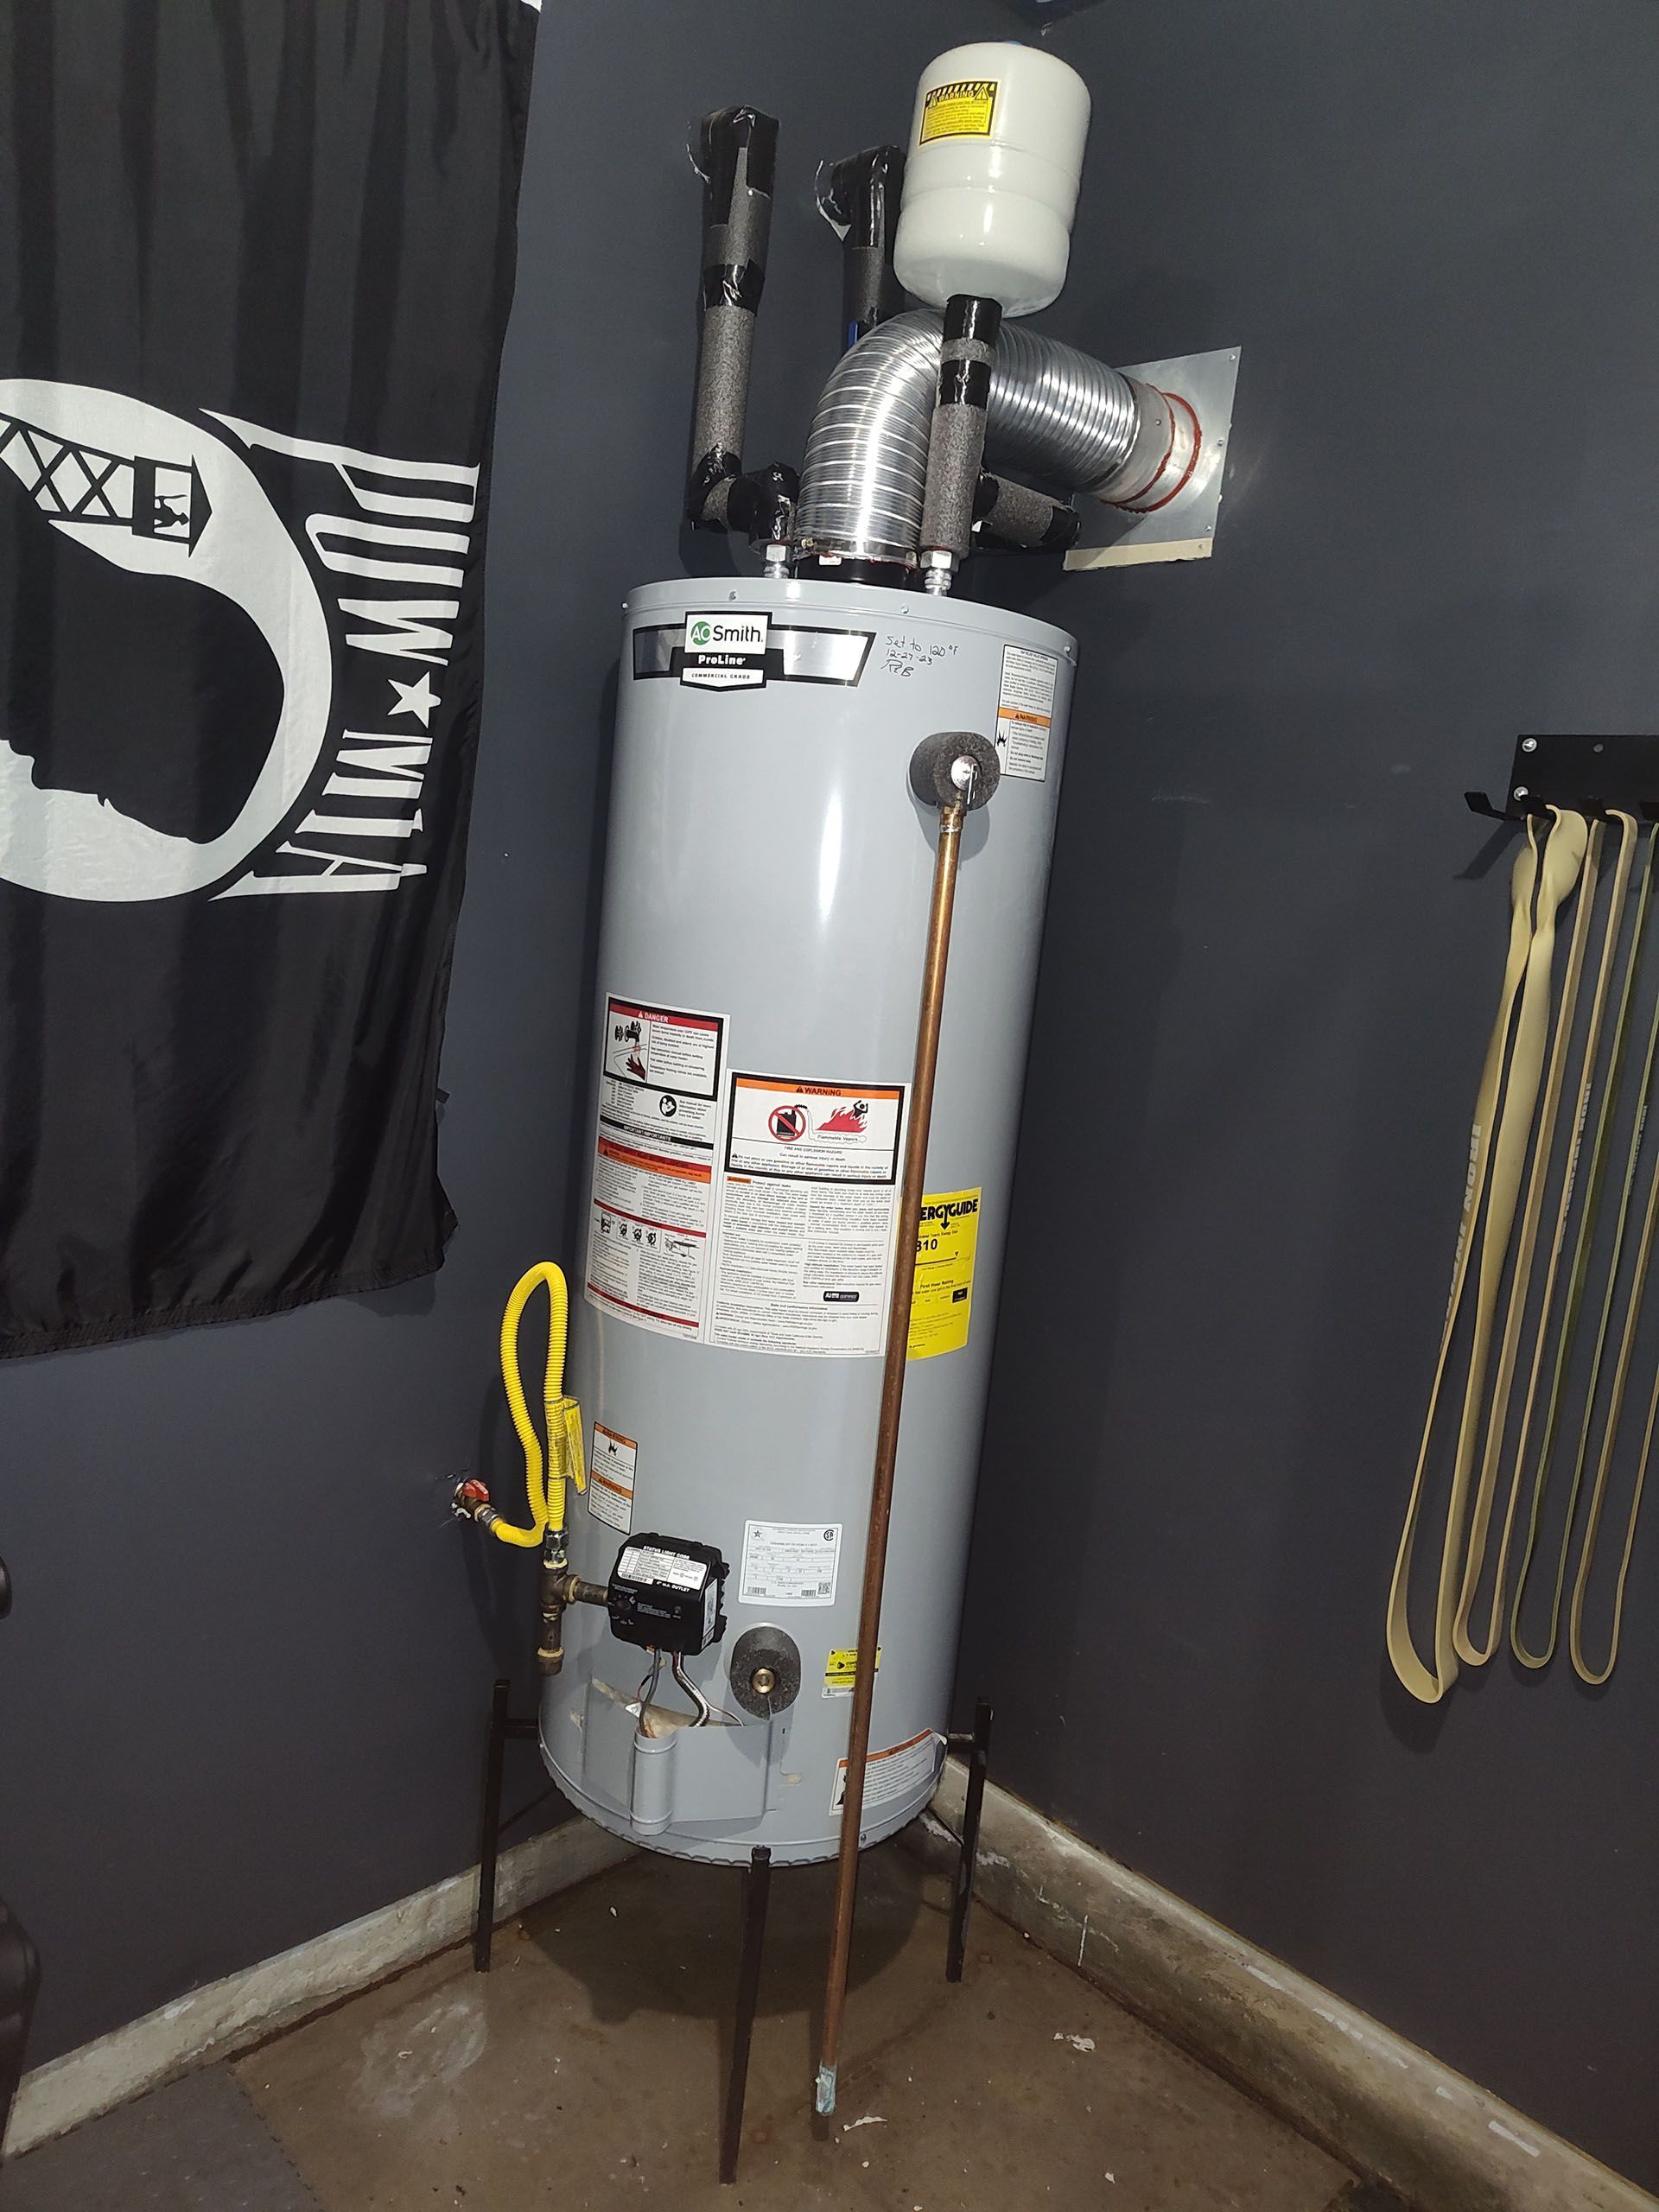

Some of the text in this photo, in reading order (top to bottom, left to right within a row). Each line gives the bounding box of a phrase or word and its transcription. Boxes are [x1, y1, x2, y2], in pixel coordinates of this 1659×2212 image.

[939, 90, 974, 102] WARNING
[886, 636, 905, 648] Set
[910, 638, 922, 652] to
[198, 408, 481, 903] POW MIA
[698, 654, 745, 665] ProLine
[644, 1012, 669, 1023] DANGER
[804, 1086, 842, 1096] WARNING
[920, 1198, 978, 1221] ERGYGUIDE
